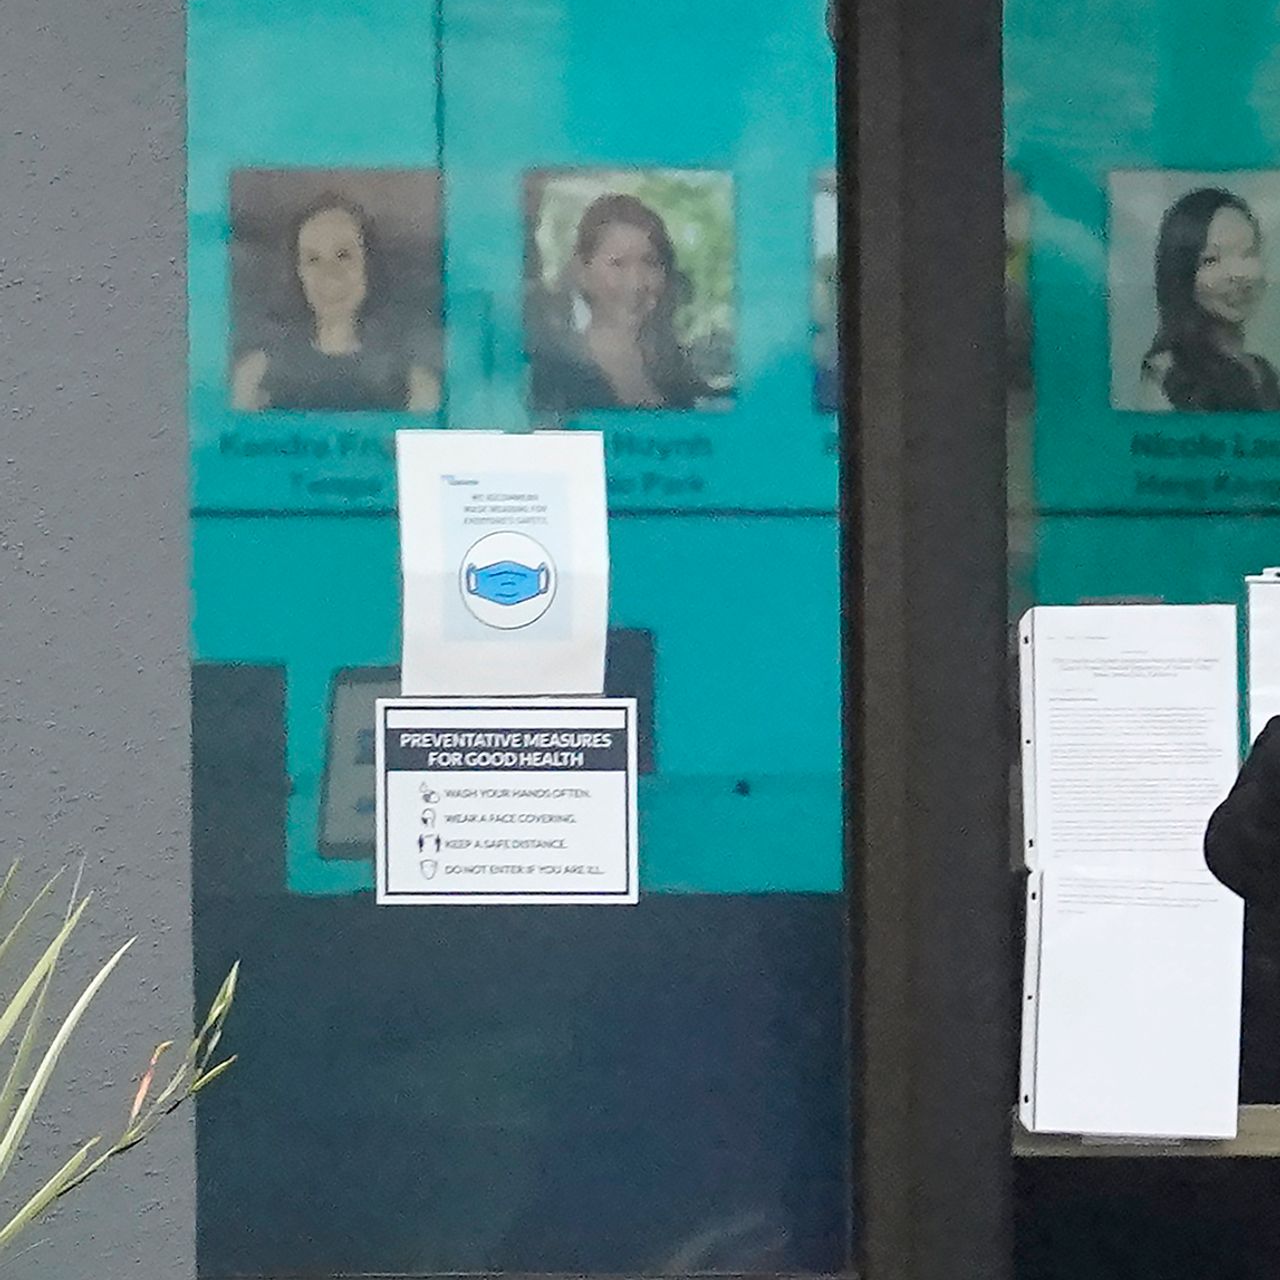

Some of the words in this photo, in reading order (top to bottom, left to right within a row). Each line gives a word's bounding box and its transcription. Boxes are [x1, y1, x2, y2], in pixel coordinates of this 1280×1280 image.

[1131, 431, 1227, 459] Nicole
[400, 733, 523, 748] PREVENTATIVE
[524, 732, 613, 748] MEASURES
[428, 752, 463, 767] FOR
[464, 752, 517, 767] GOOD
[521, 751, 585, 767] HEALTH
[445, 788, 478, 799] WASH
[480, 788, 511, 799] YOUR
[513, 788, 550, 799] HANDS
[444, 813, 477, 824] WEAR
[489, 813, 517, 824] FACE
[445, 839, 472, 850] KEEP
[484, 839, 509, 850] SAFE
[445, 864, 462, 875] DO
[463, 864, 487, 875] NOT
[489, 864, 523, 875] ENTER
[540, 864, 563, 875] YOU
[564, 864, 586, 875] ARE
